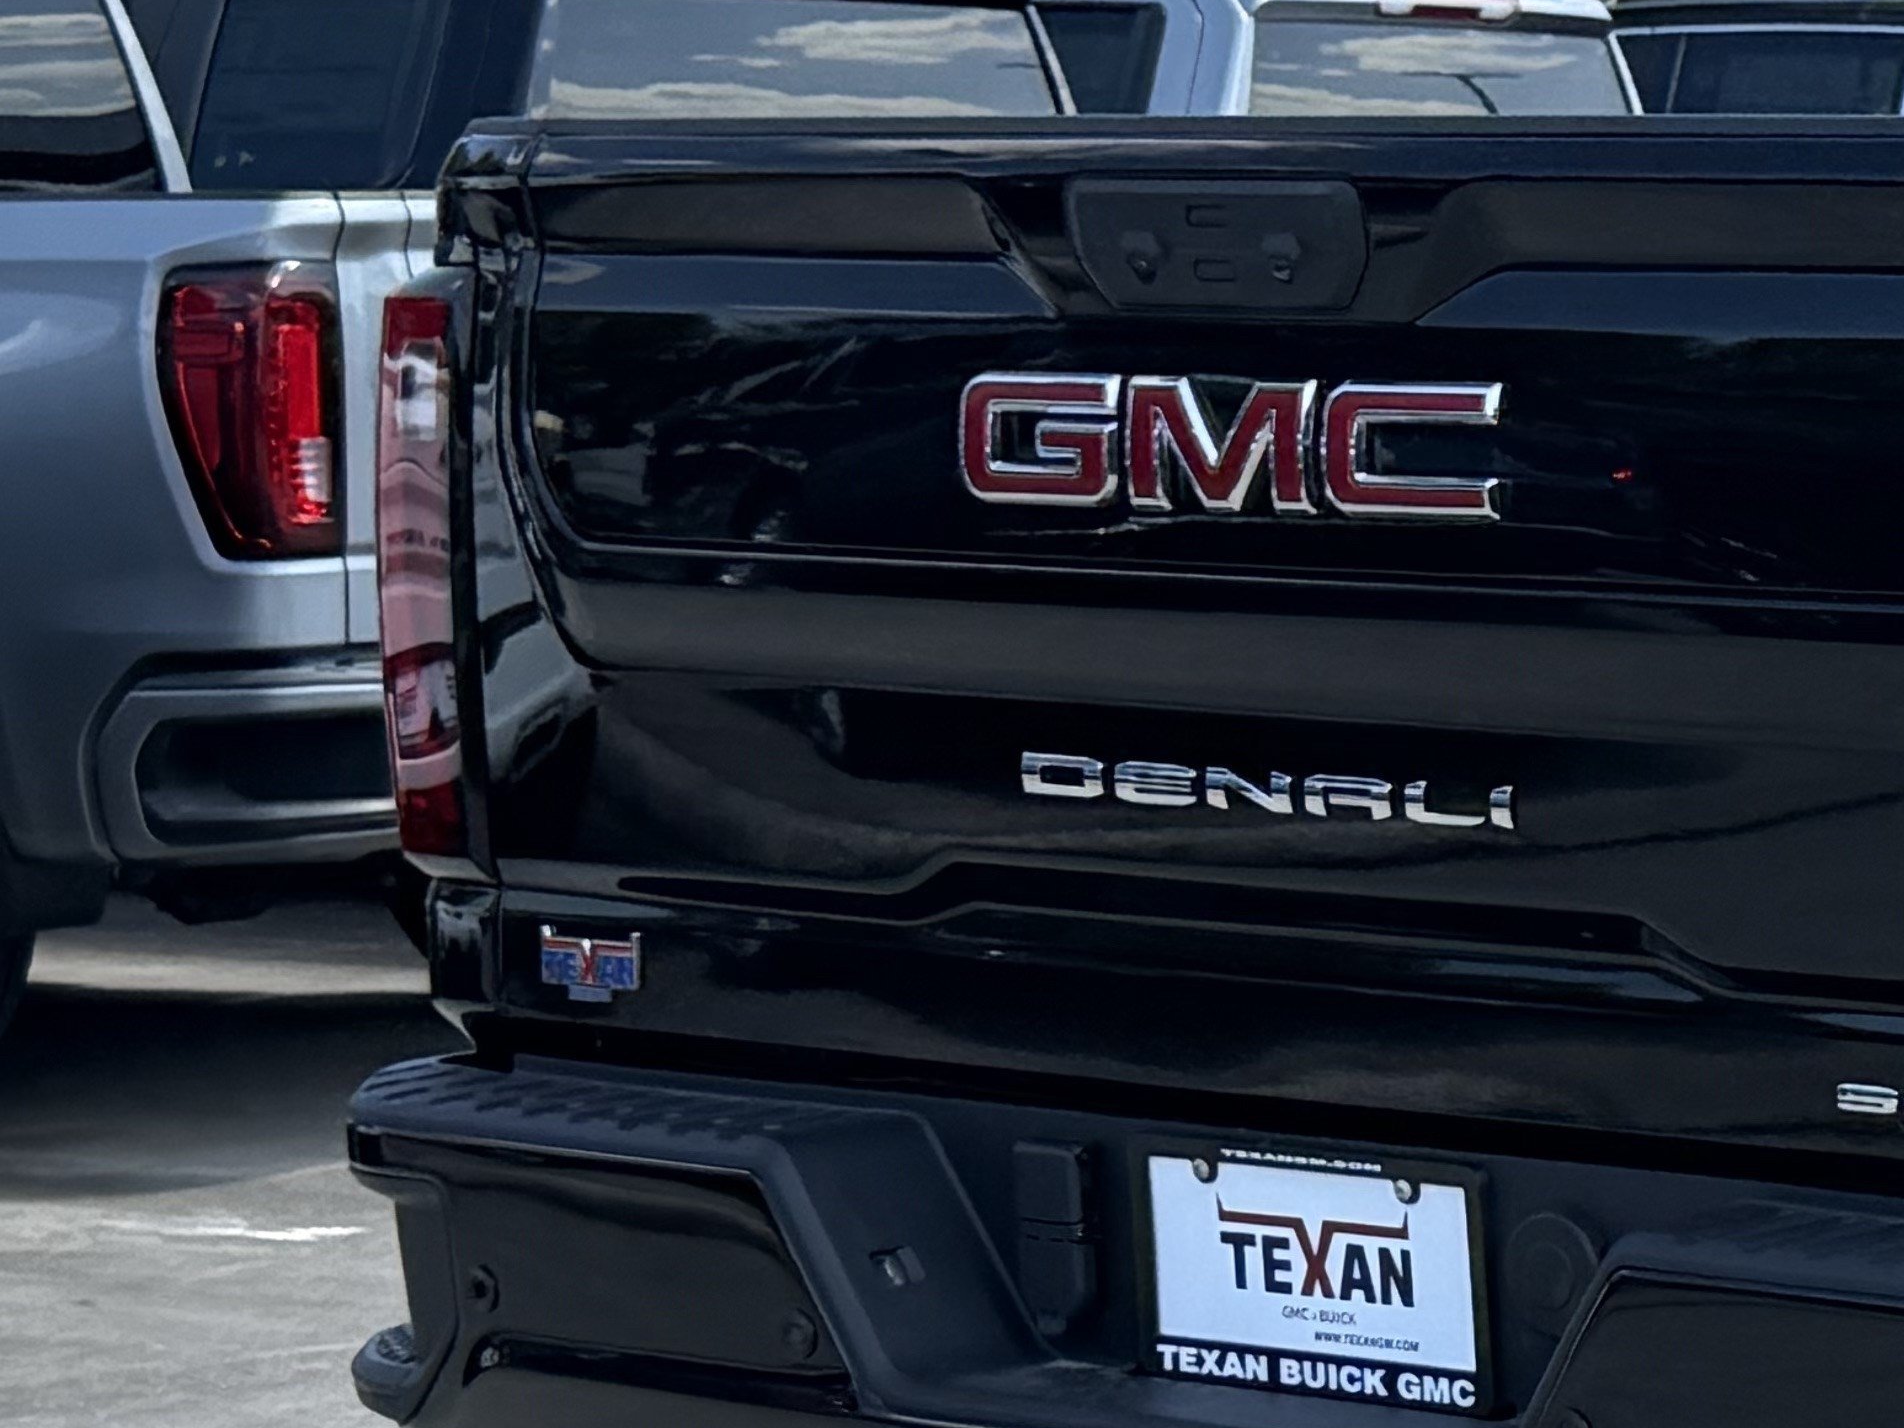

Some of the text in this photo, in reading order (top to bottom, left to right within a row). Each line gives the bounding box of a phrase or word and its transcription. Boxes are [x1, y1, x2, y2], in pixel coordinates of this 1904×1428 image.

[959, 372, 1503, 521] GMC
[1021, 751, 1517, 830] DENALI
[1217, 1210, 1415, 1308] TEXAN
[1156, 1344, 1476, 1408] TEXAN BUICK GMC
